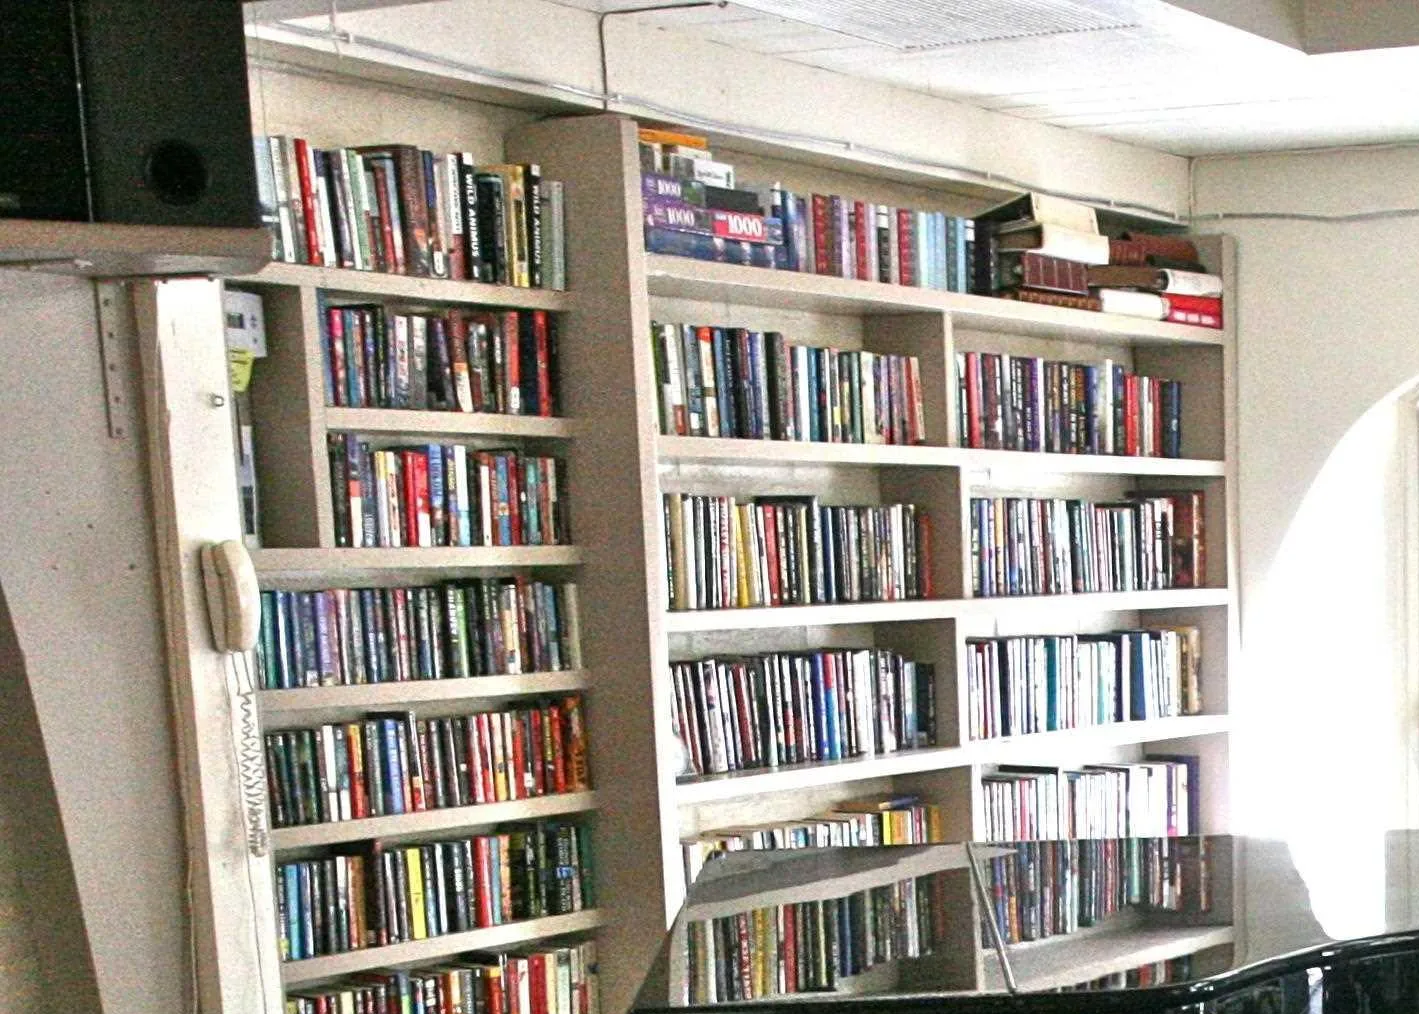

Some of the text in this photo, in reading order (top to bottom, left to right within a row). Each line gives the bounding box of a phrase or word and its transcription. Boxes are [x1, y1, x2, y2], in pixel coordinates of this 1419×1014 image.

[465, 173, 480, 257] WILD ANIMUS
[729, 214, 762, 237] 1000
